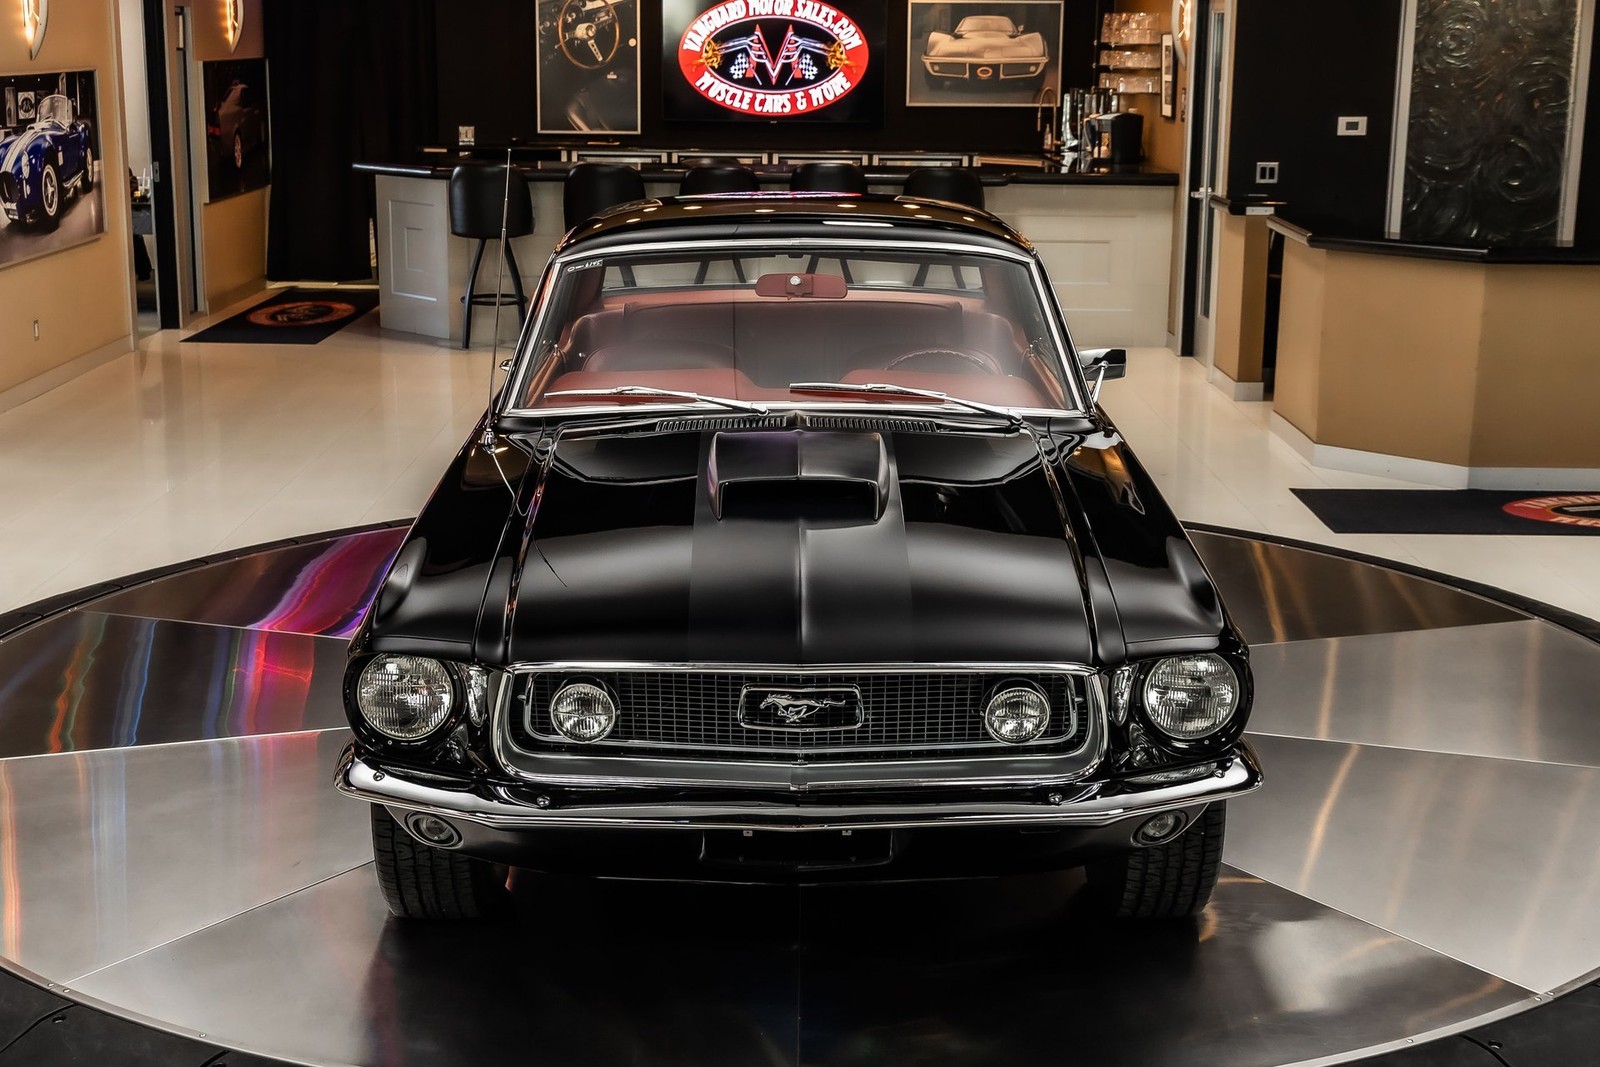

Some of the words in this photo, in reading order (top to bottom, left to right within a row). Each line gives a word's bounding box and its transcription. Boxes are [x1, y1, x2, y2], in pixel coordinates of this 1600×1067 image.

[683, 0, 747, 52] VANGUARD
[747, 0, 793, 17] MOTOR
[794, 0, 863, 50] SALES.COM
[694, 71, 751, 111] MUSCLE
[754, 93, 791, 113] CARS
[796, 92, 807, 111] &
[809, 72, 852, 107] MORE
